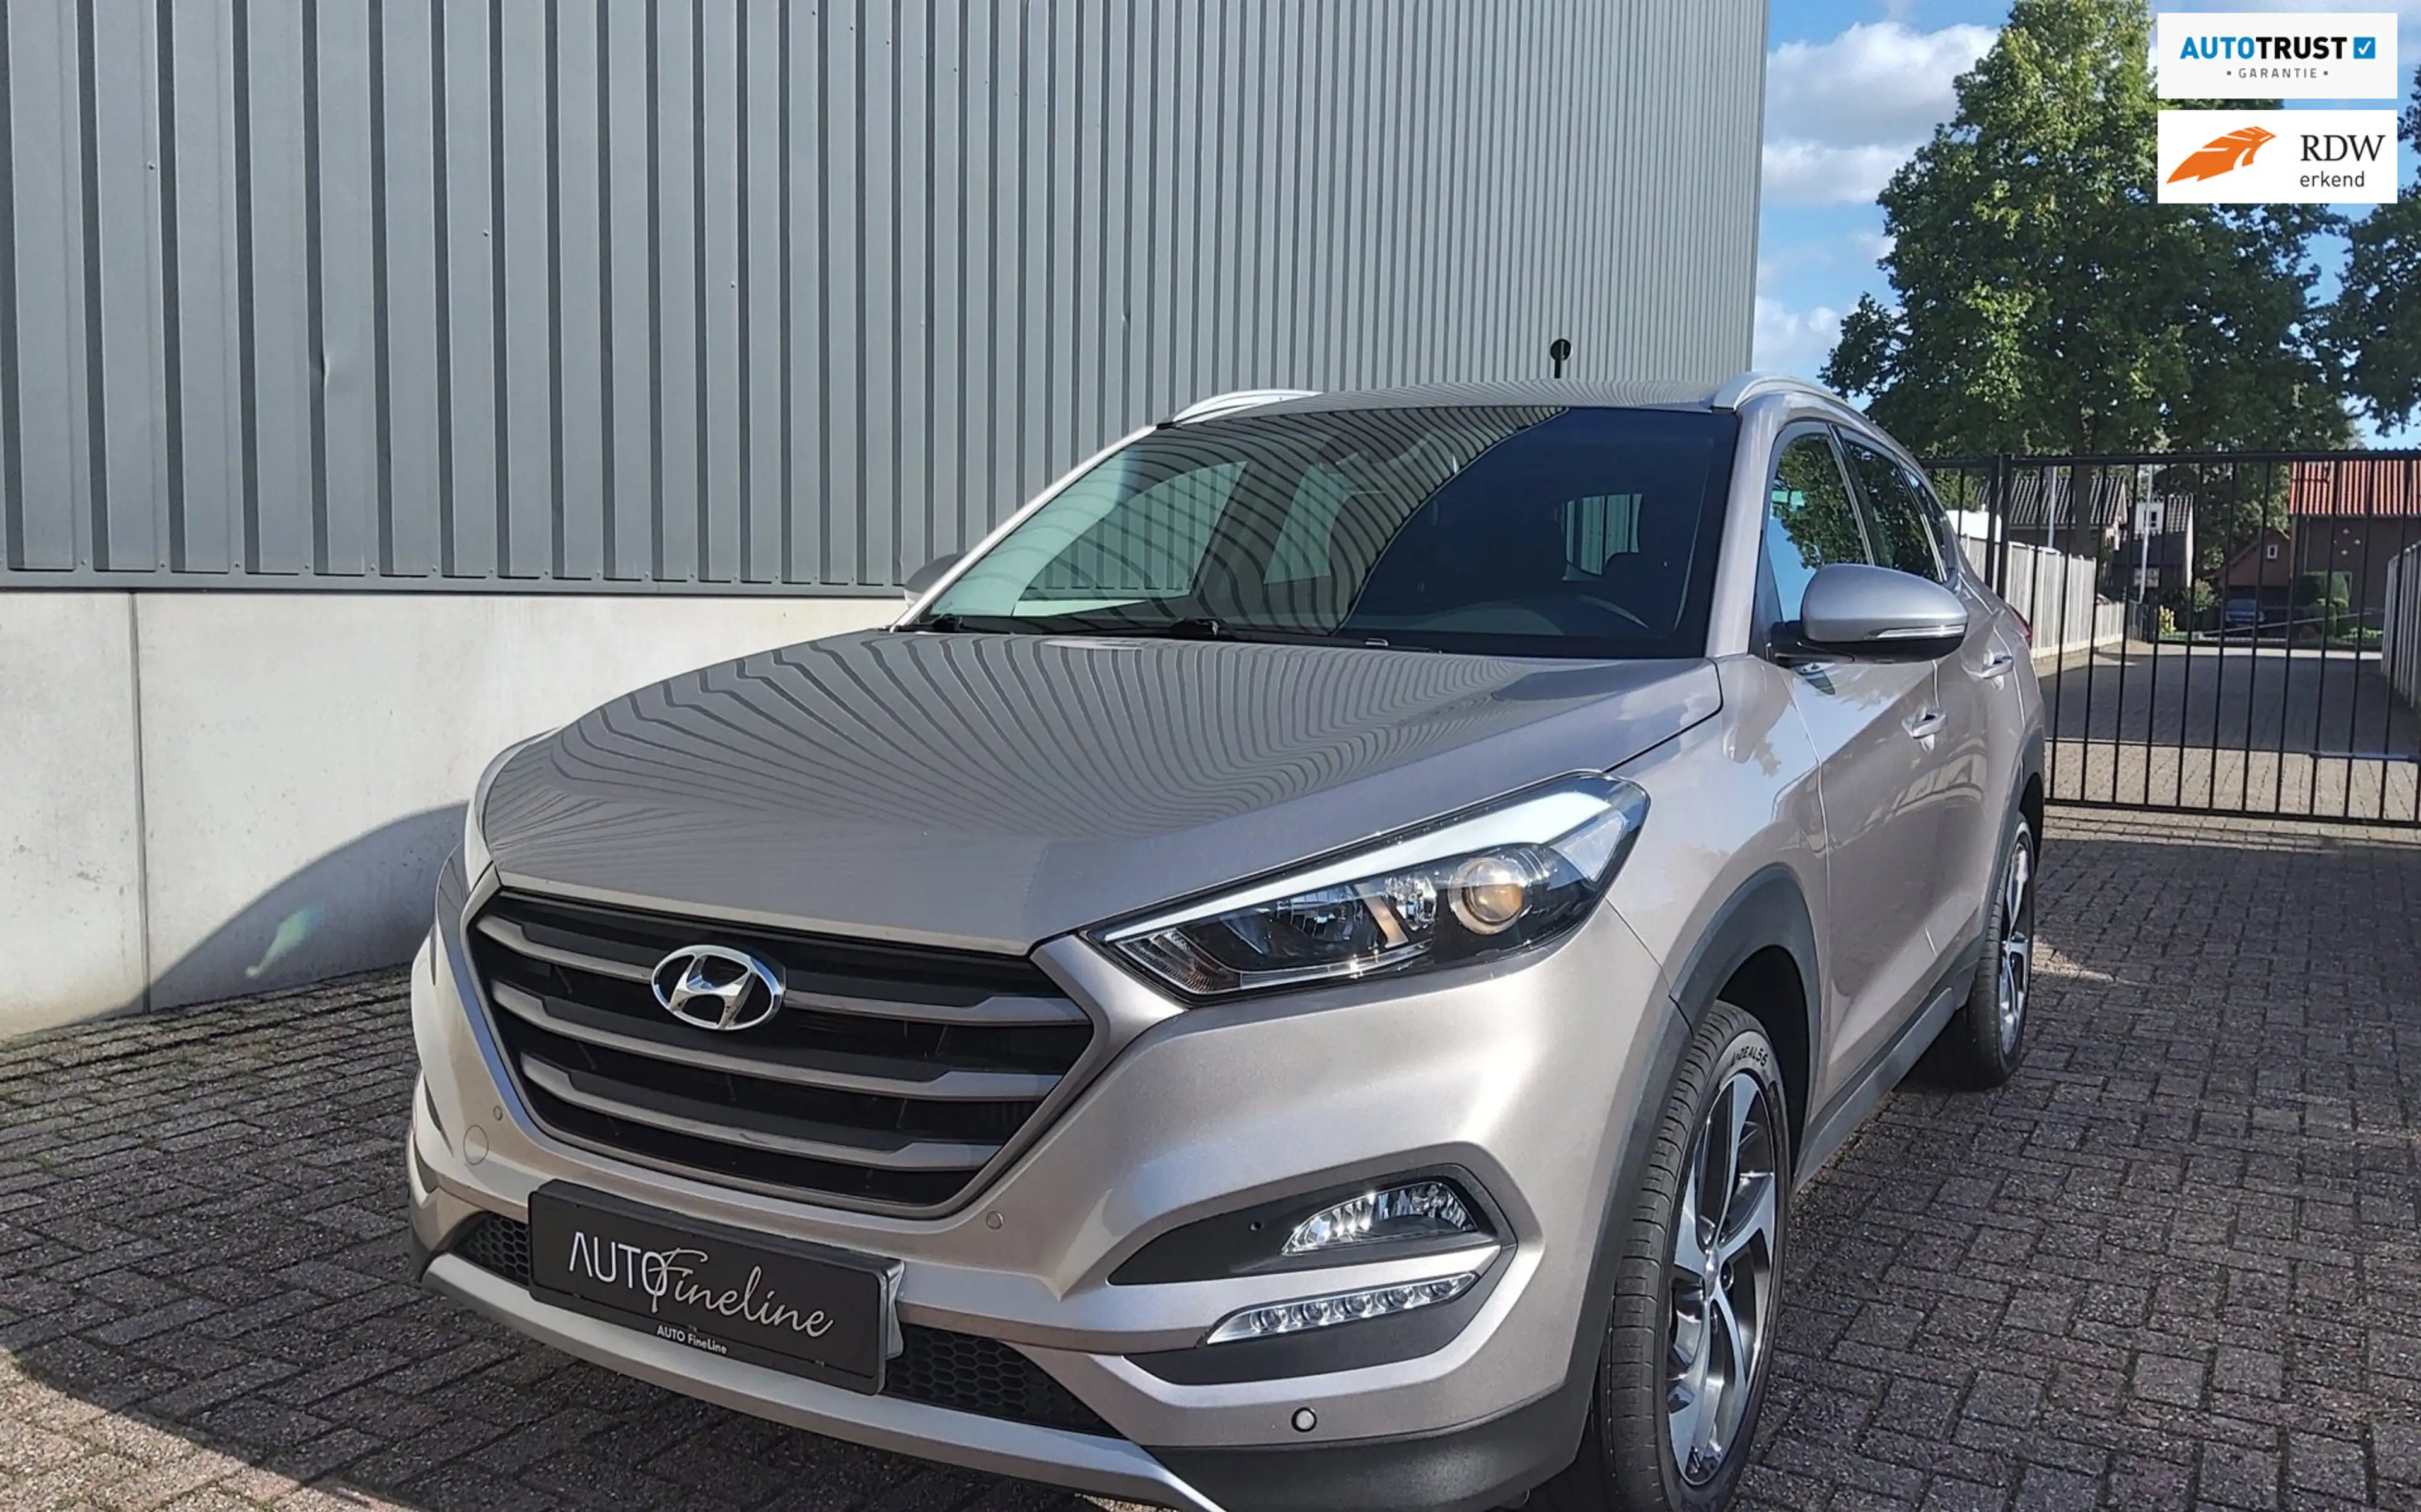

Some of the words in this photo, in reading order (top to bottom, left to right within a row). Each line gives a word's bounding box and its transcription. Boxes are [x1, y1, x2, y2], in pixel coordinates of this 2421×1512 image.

[569, 1231, 668, 1297] AUTO
[657, 1324, 686, 1342] AUTO
[687, 1332, 728, 1355] FineLine
